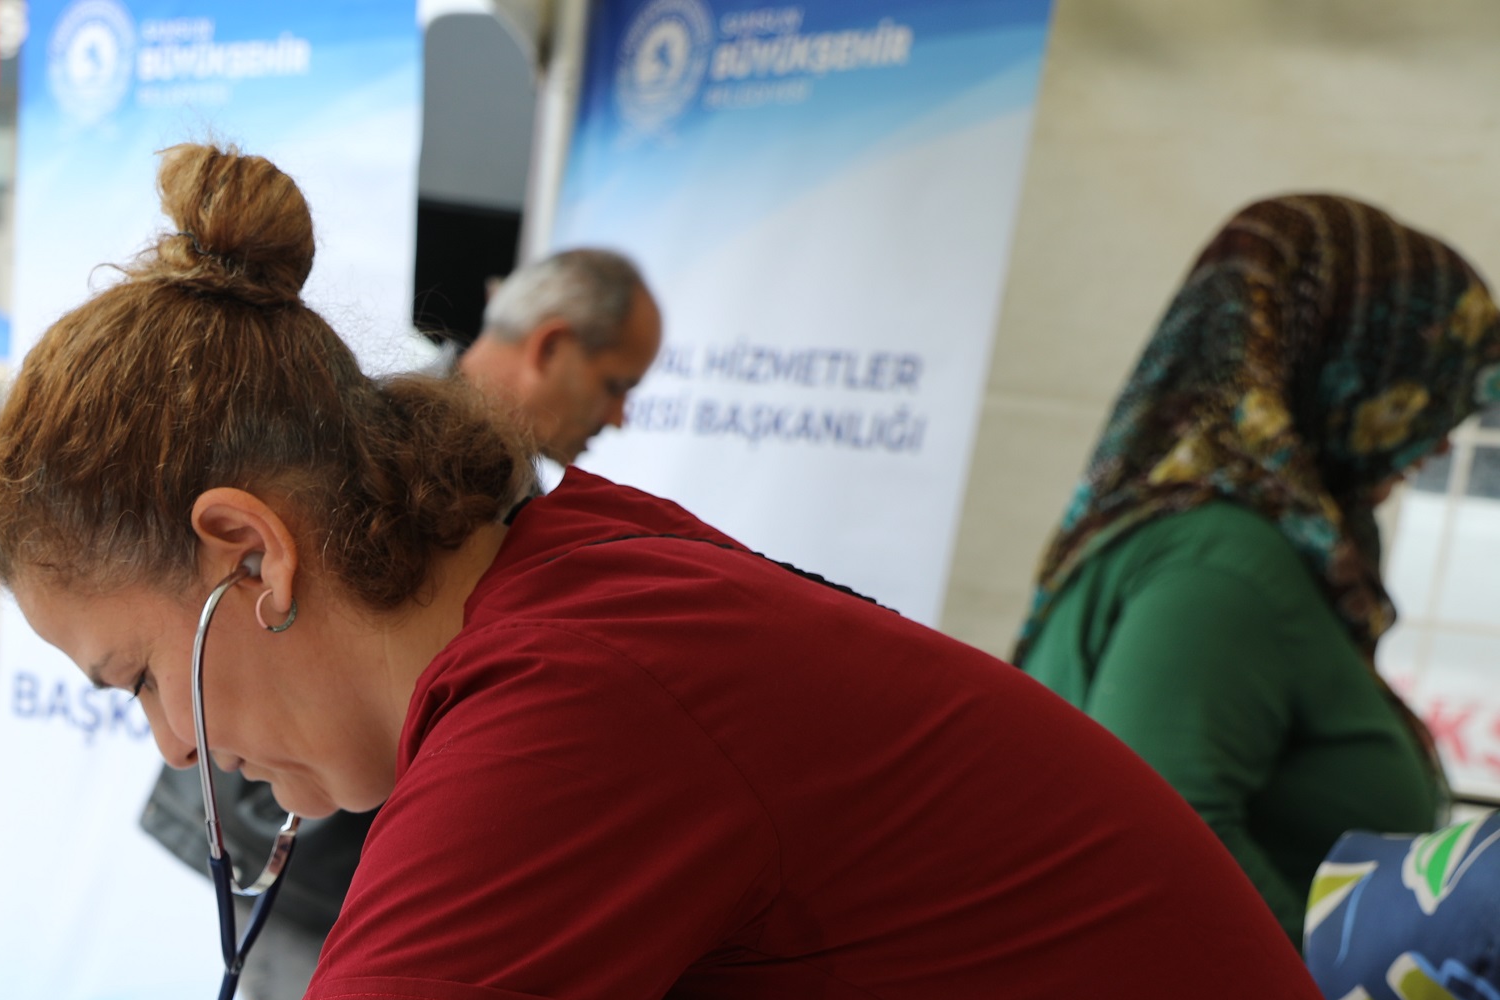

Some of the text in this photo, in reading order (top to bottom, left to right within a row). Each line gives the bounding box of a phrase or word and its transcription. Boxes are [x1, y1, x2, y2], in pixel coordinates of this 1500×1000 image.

[710, 17, 912, 80] BÜYÜKŞEHİR
[703, 338, 922, 393] HİZMETLER
[693, 397, 928, 452] BAŞKANLIĞI
[11, 671, 152, 747] BAŞK
